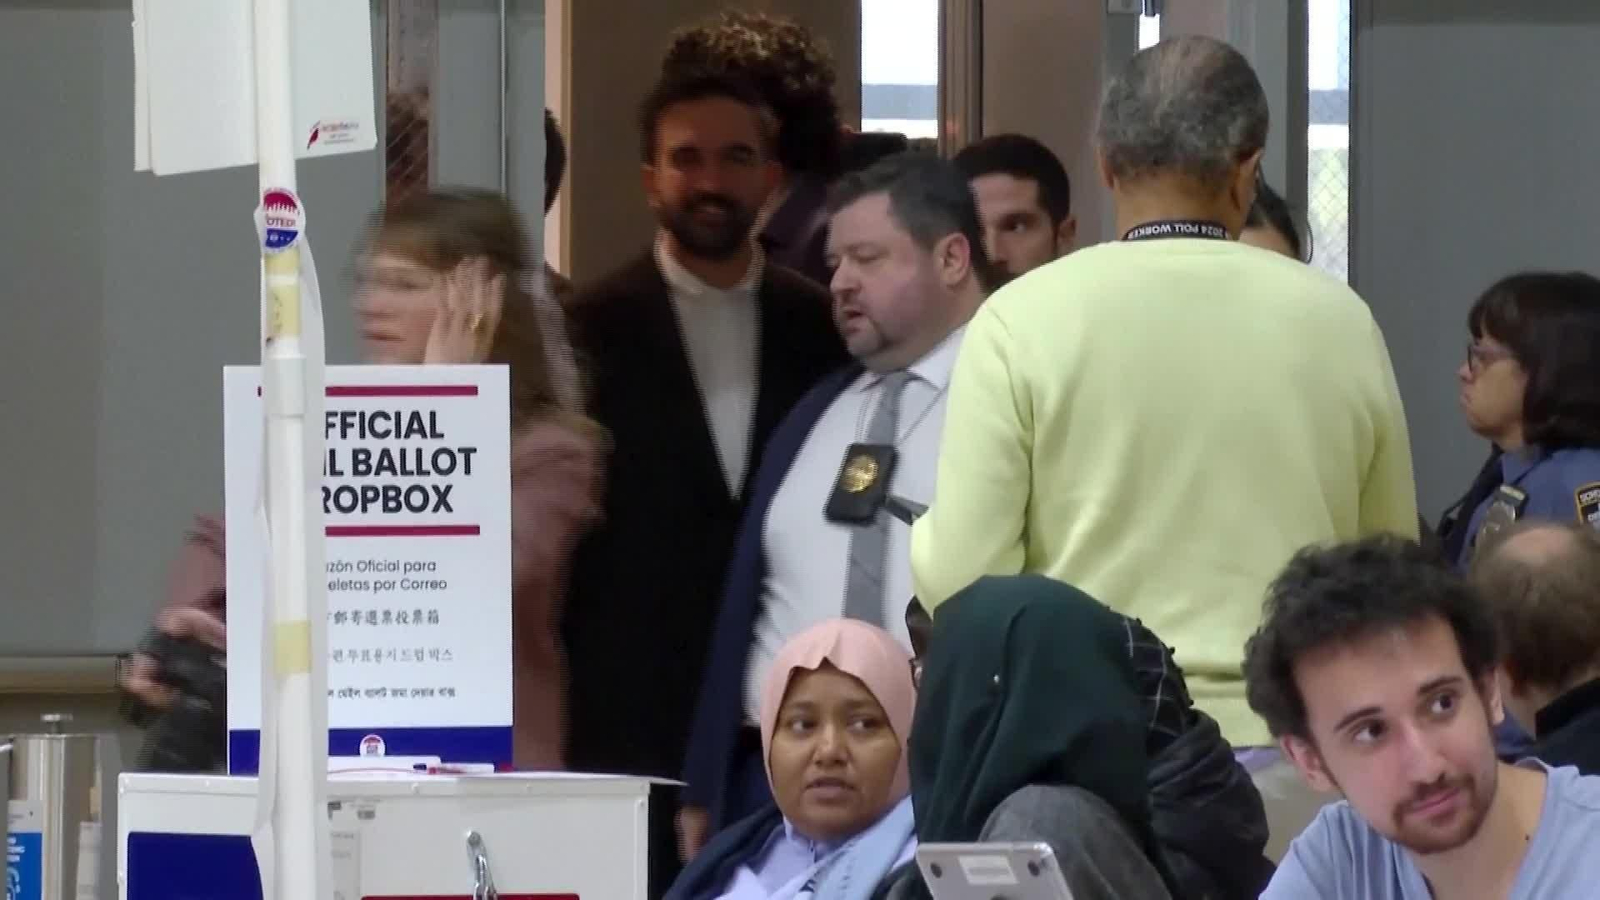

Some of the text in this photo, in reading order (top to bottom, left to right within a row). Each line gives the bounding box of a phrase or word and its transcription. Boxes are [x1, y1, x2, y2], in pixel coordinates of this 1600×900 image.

[1128, 223, 1223, 239] 2024 POLL WORKER
[325, 410, 444, 439] FFICIAL
[352, 447, 477, 476] BALLOT
[322, 484, 453, 514] ROPBOX
[357, 560, 400, 573] Oficial
[404, 561, 436, 575] para
[328, 578, 447, 594] eletas por Correo
[328, 609, 439, 626] 郵寄選票投票箱
